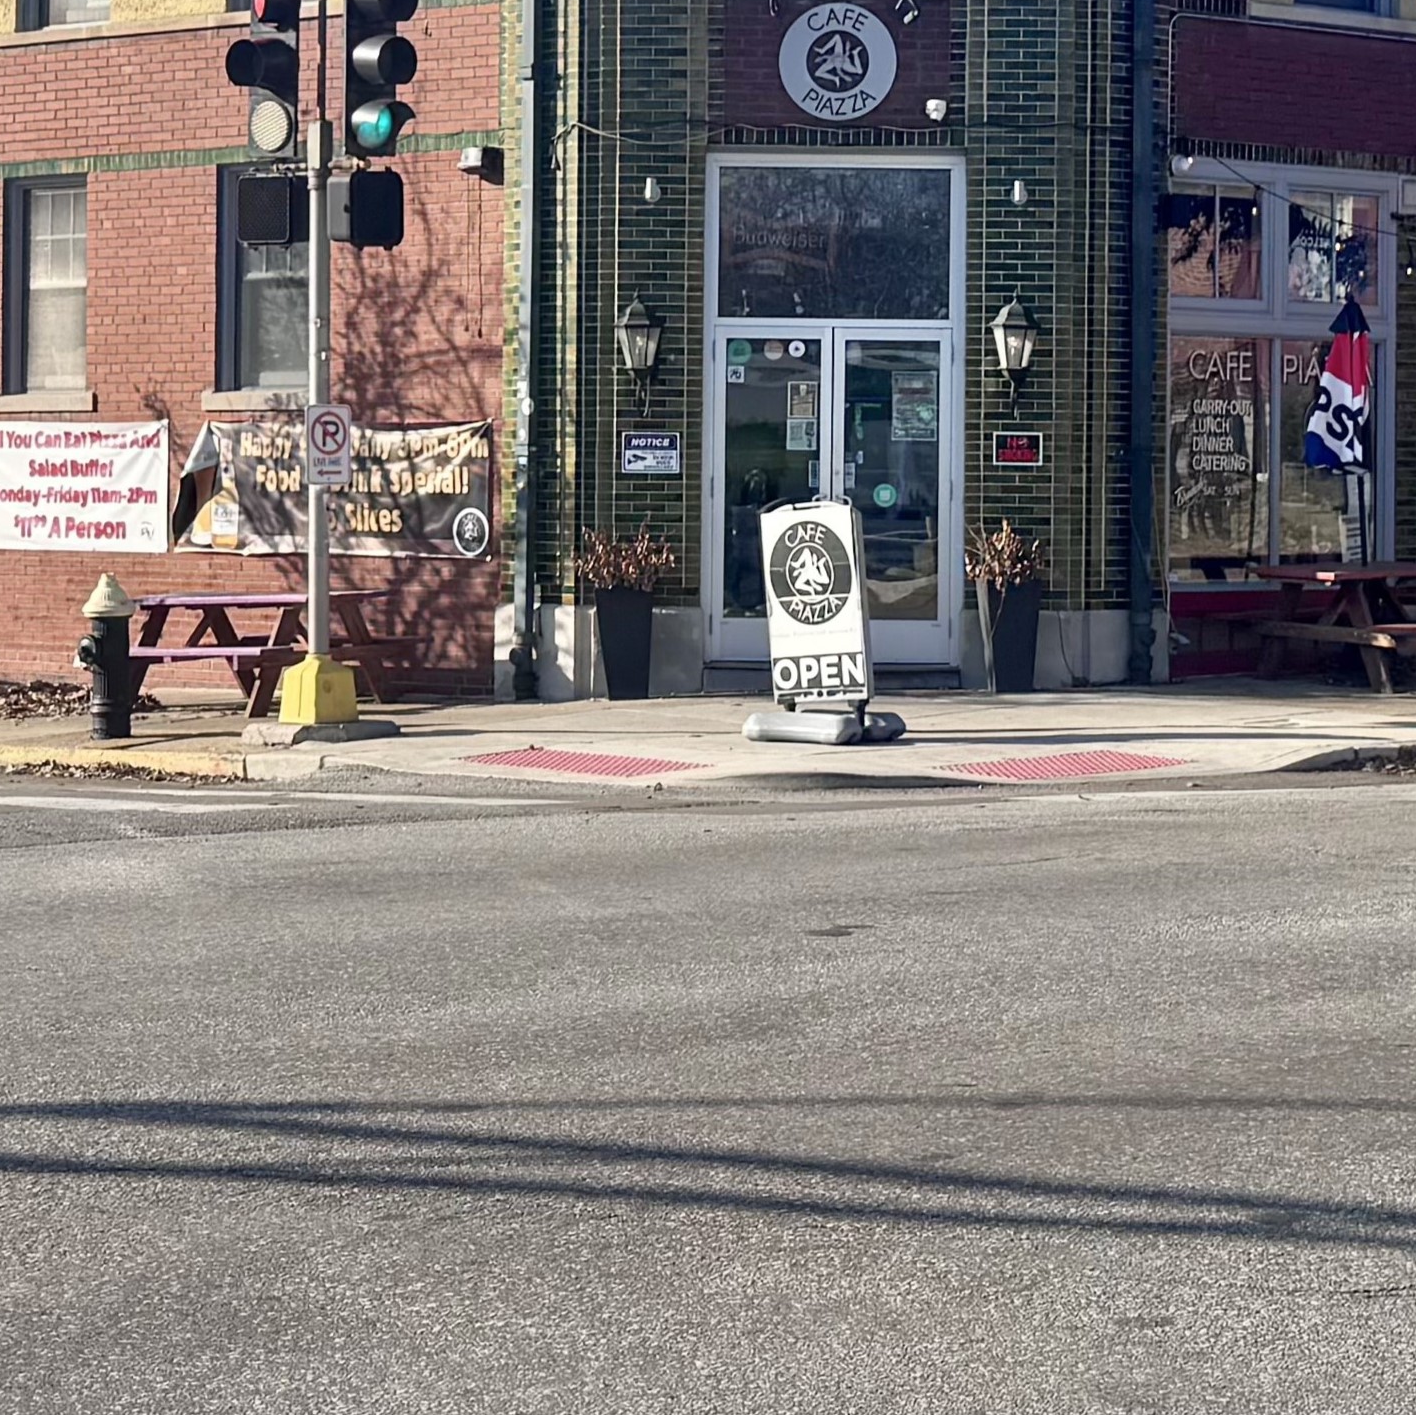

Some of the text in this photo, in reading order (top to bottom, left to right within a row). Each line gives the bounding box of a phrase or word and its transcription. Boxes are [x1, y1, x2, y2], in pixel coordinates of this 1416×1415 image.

[807, 7, 869, 32] CAFE
[801, 88, 877, 116] PIAZZA
[732, 224, 826, 249] Budweiser
[1189, 349, 1253, 382] CAFE
[1192, 399, 1252, 417] CARRY-OUT
[1192, 418, 1230, 434] LUNCH
[6, 431, 32, 449] You
[35, 431, 62, 449] Can
[64, 430, 86, 449] Eat
[129, 429, 161, 450] And
[630, 437, 670, 447] NOTICE
[1192, 436, 1235, 453] DINNER
[28, 459, 115, 478] Salad Buffet
[1192, 453, 1247, 472] CATERING
[255, 463, 302, 493] Food
[47, 516, 62, 539] A
[65, 516, 127, 540] Person
[344, 502, 404, 534] Slices
[784, 524, 828, 548] CAFE
[788, 596, 843, 623] PIAZZA
[773, 652, 866, 691] OPEN
